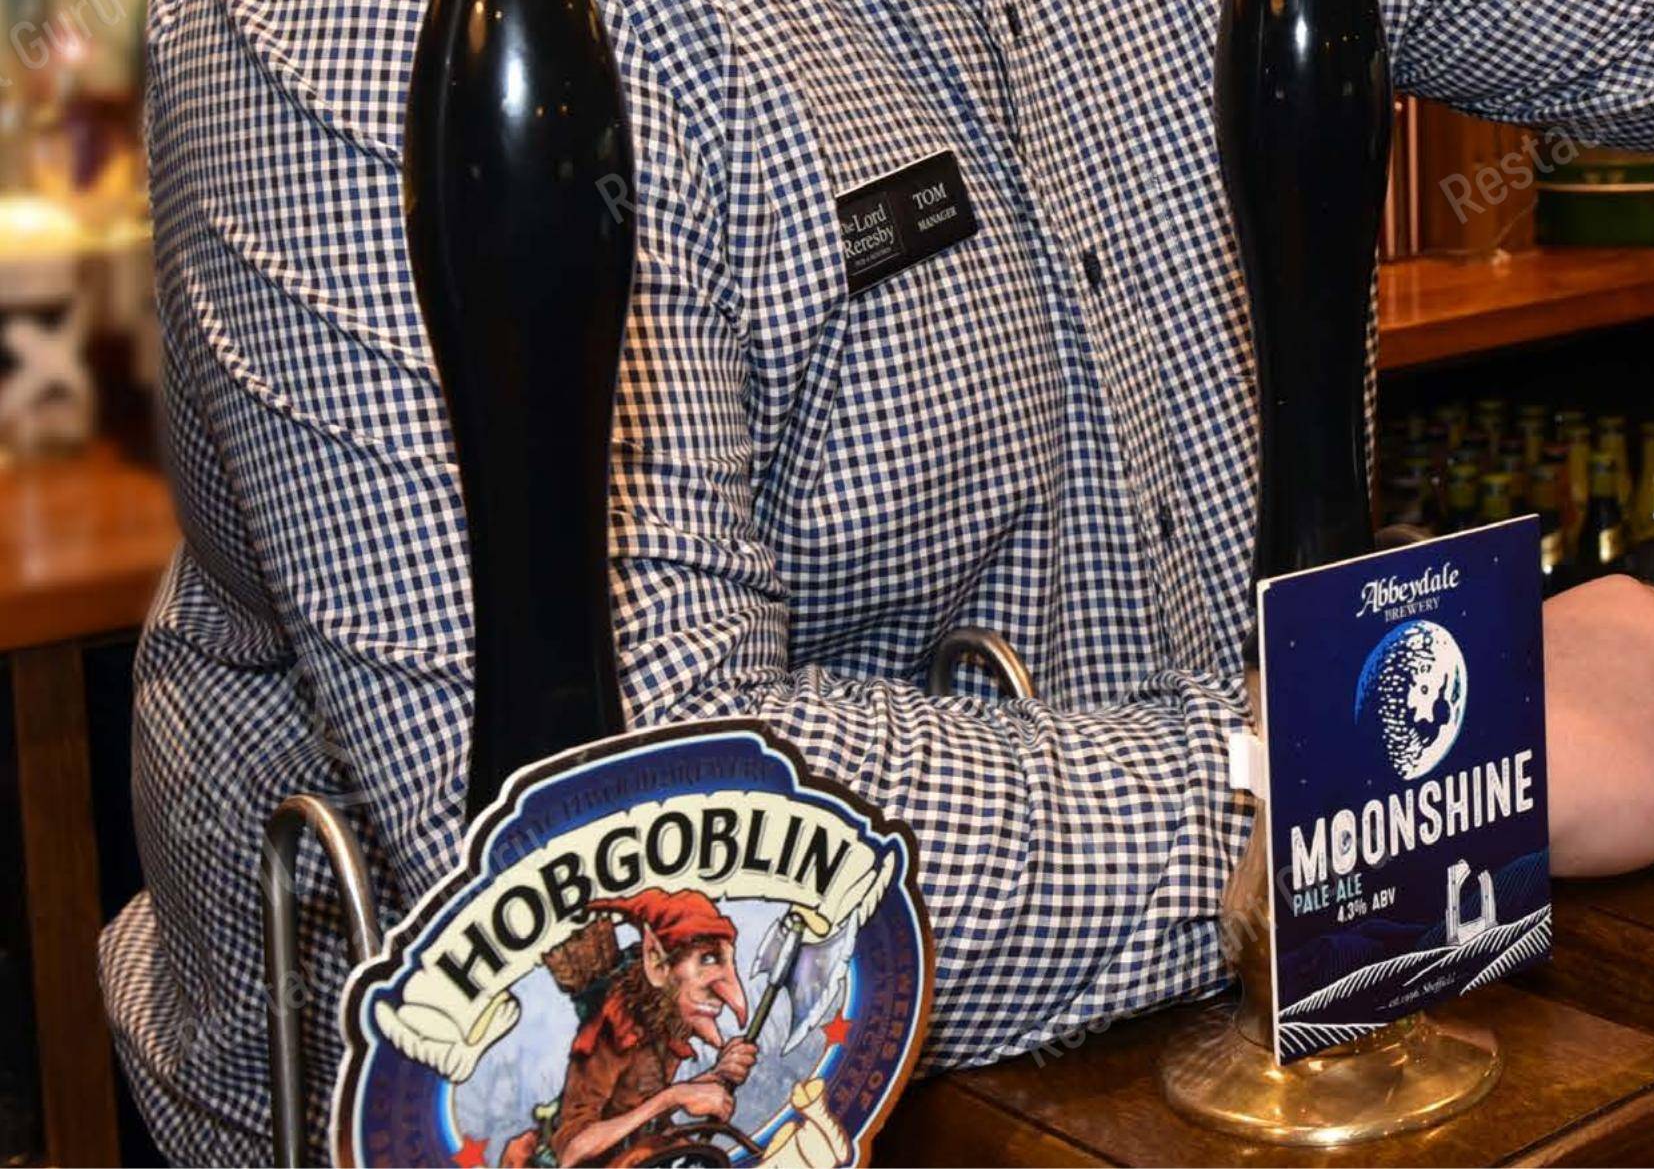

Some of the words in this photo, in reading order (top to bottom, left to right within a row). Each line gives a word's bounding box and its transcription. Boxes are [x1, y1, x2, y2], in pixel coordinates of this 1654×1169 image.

[913, 183, 947, 210] TOM
[853, 203, 887, 232] Lord
[917, 206, 957, 231] MANAGER
[843, 225, 894, 259] Reresby
[1356, 562, 1460, 618] Abbeydale
[1384, 596, 1440, 623] BREWERY
[1291, 749, 1534, 891] MOONSHINE
[435, 807, 851, 1001] HOBGOBLIN
[1293, 885, 1330, 917] PALE
[1336, 873, 1362, 900] ALE
[1372, 887, 1397, 912] ABV
